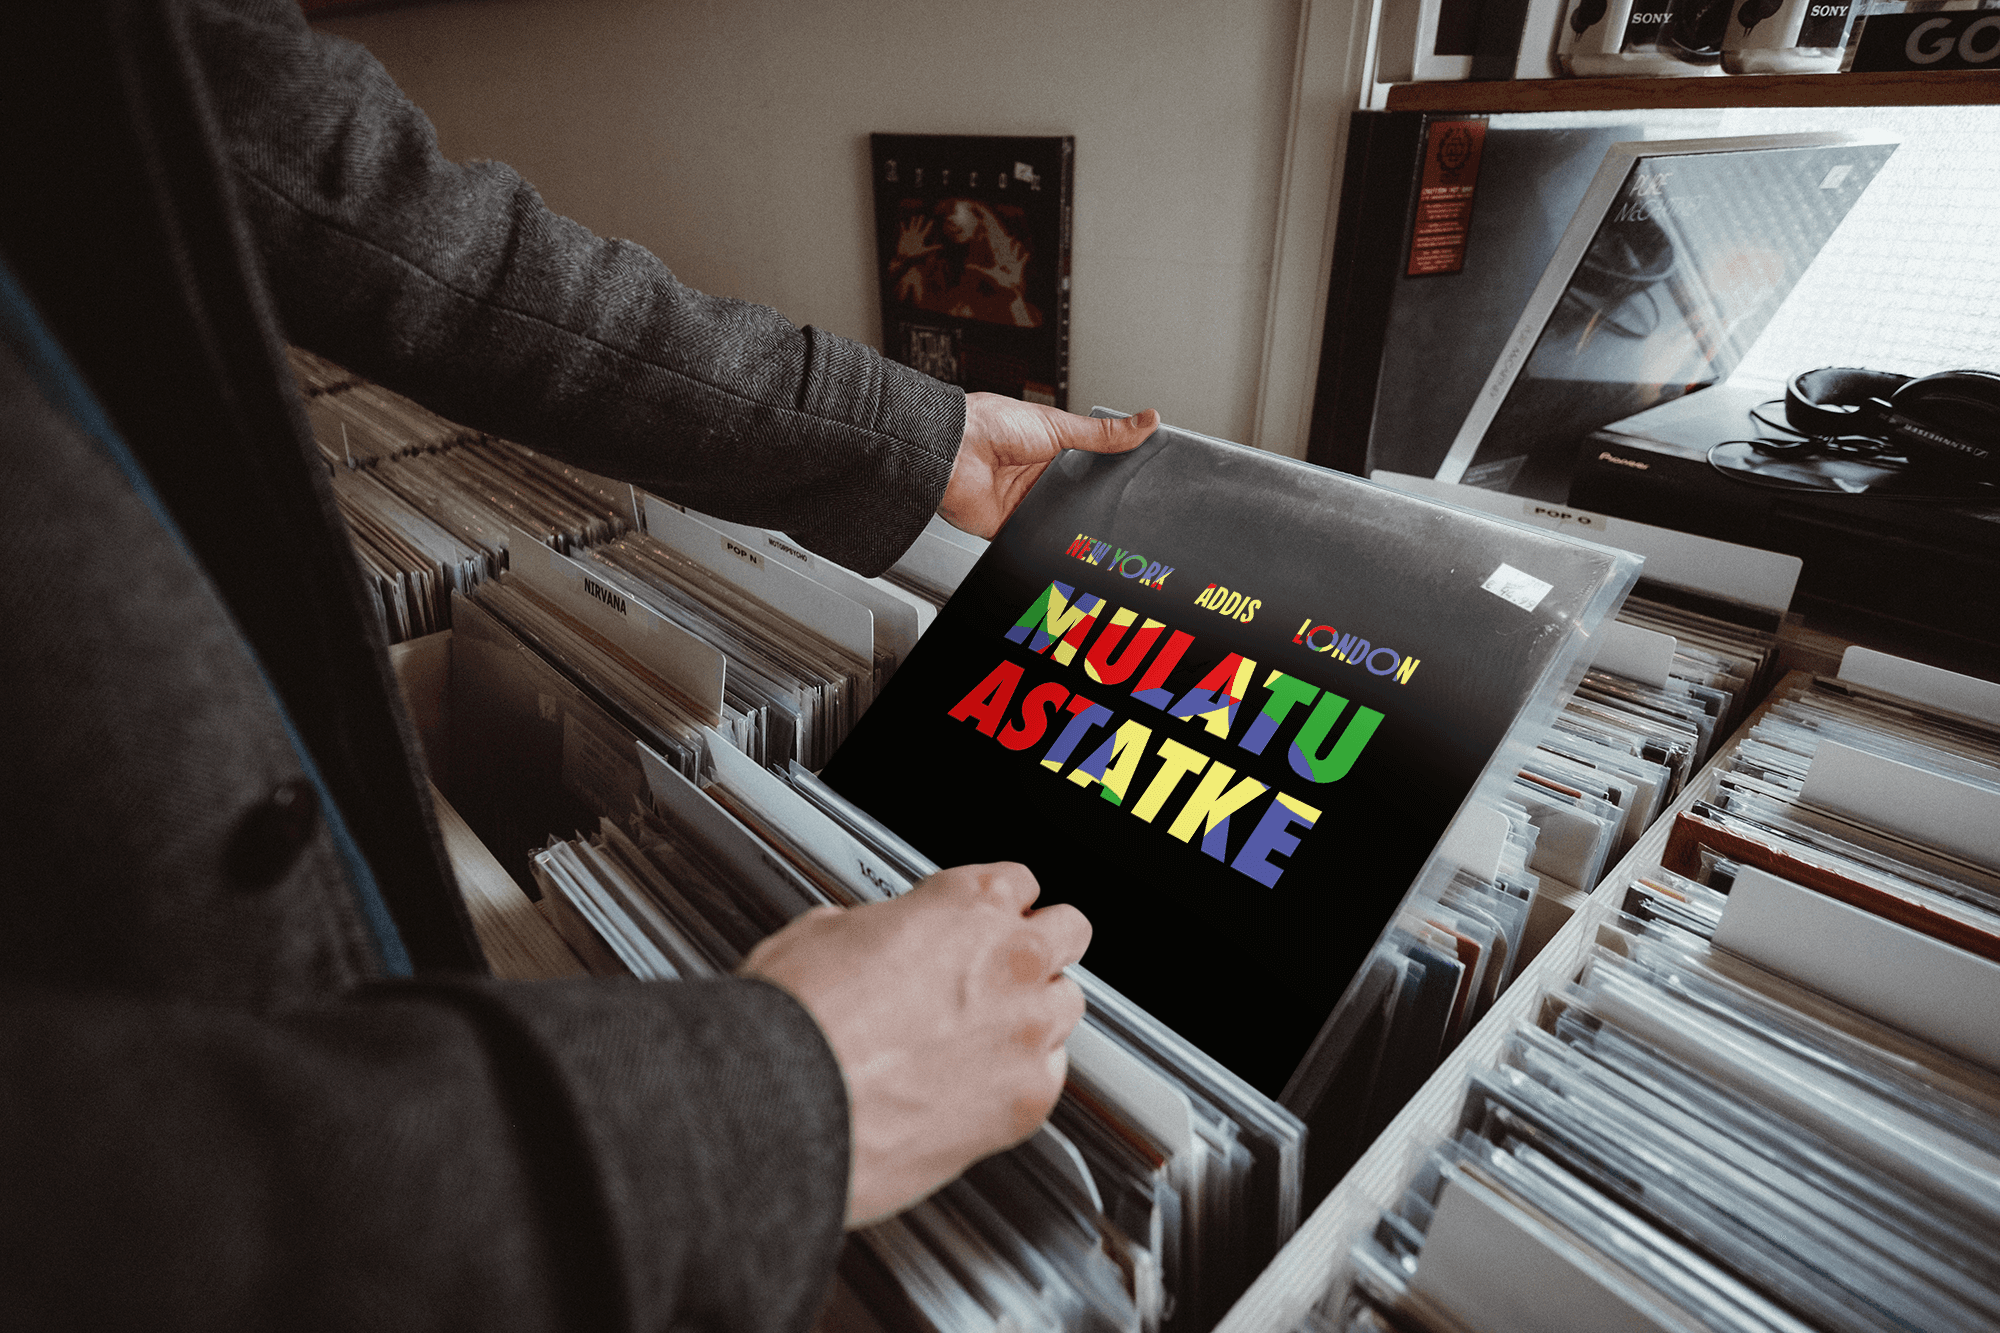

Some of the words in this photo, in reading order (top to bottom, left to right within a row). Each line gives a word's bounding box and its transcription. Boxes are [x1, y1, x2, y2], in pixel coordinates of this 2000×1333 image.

[1632, 13, 1673, 24] SONY
[1810, 5, 1849, 17] SONY
[1904, 423, 1973, 452] SENNHEISER
[1598, 451, 1650, 470] Pioneer
[1535, 507, 1572, 519] POP
[1577, 516, 1591, 525] O
[727, 542, 747, 557] POP
[749, 554, 757, 564] N
[1065, 533, 1112, 566] NEW
[1107, 548, 1175, 590] YORK
[584, 577, 627, 616] NIRVANA
[1194, 583, 1262, 624] ADDIS
[1292, 618, 1421, 685] LONDON
[1004, 579, 1386, 784] MULATU
[947, 659, 1323, 889] ASTATKE
